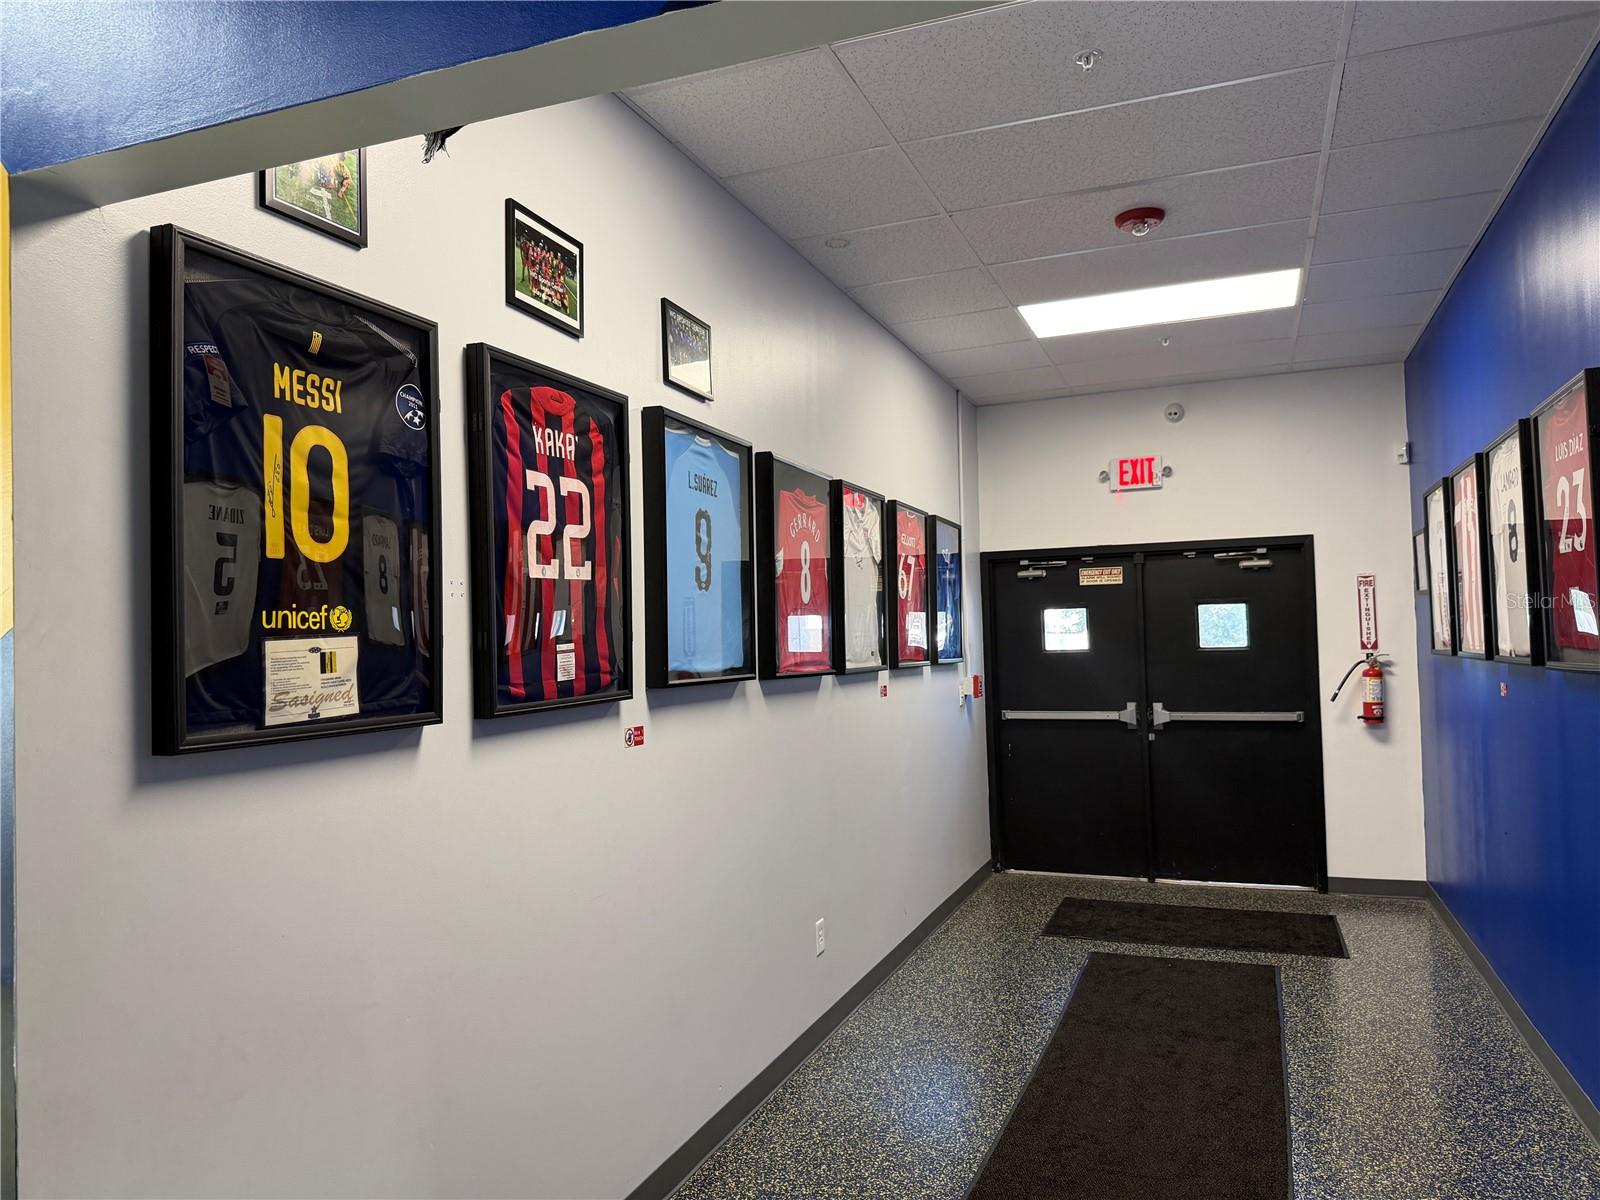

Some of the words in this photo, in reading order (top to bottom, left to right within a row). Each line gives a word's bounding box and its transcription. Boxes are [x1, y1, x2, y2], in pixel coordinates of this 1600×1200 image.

[274, 362, 342, 413] MESSI
[1119, 457, 1155, 486] EXIT
[1555, 442, 1569, 462] LUIS
[263, 414, 349, 563] 10
[1556, 467, 1587, 554] 23
[525, 469, 592, 580] 22
[695, 507, 712, 592] 9
[789, 512, 821, 543] GERRARD
[1507, 498, 1518, 563] 8
[800, 540, 811, 605] 8
[898, 553, 916, 601] 67
[1359, 579, 1373, 587] FIRE
[262, 603, 328, 630] unicef
[1364, 588, 1372, 645] EXTINGUISHER
